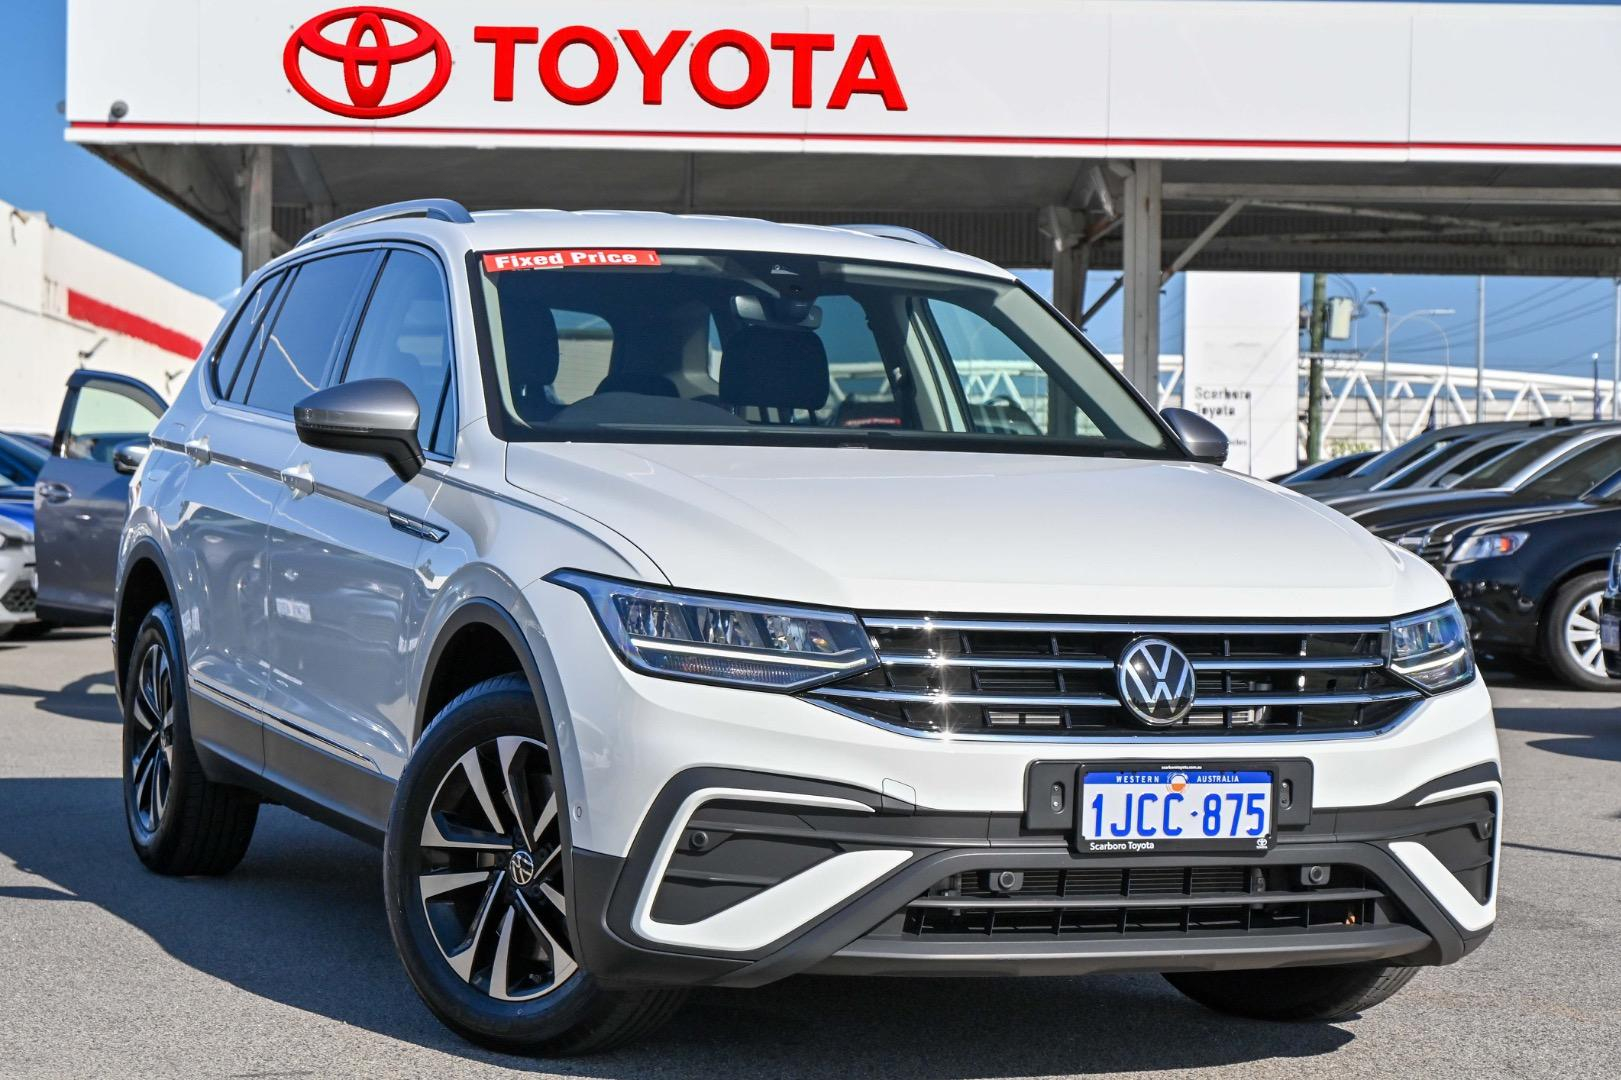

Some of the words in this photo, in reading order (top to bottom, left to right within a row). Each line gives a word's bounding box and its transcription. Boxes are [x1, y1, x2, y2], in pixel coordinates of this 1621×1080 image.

[474, 25, 909, 111] TOYOTA
[495, 252, 564, 269] Fixed
[570, 251, 638, 264] Price
[1122, 641, 1192, 719] VW
[1115, 775, 1160, 784] WESTERN
[1196, 775, 1240, 783] AUSTRALIA
[1089, 842, 1127, 851] Scarboro
[1128, 841, 1155, 852] Toyota
